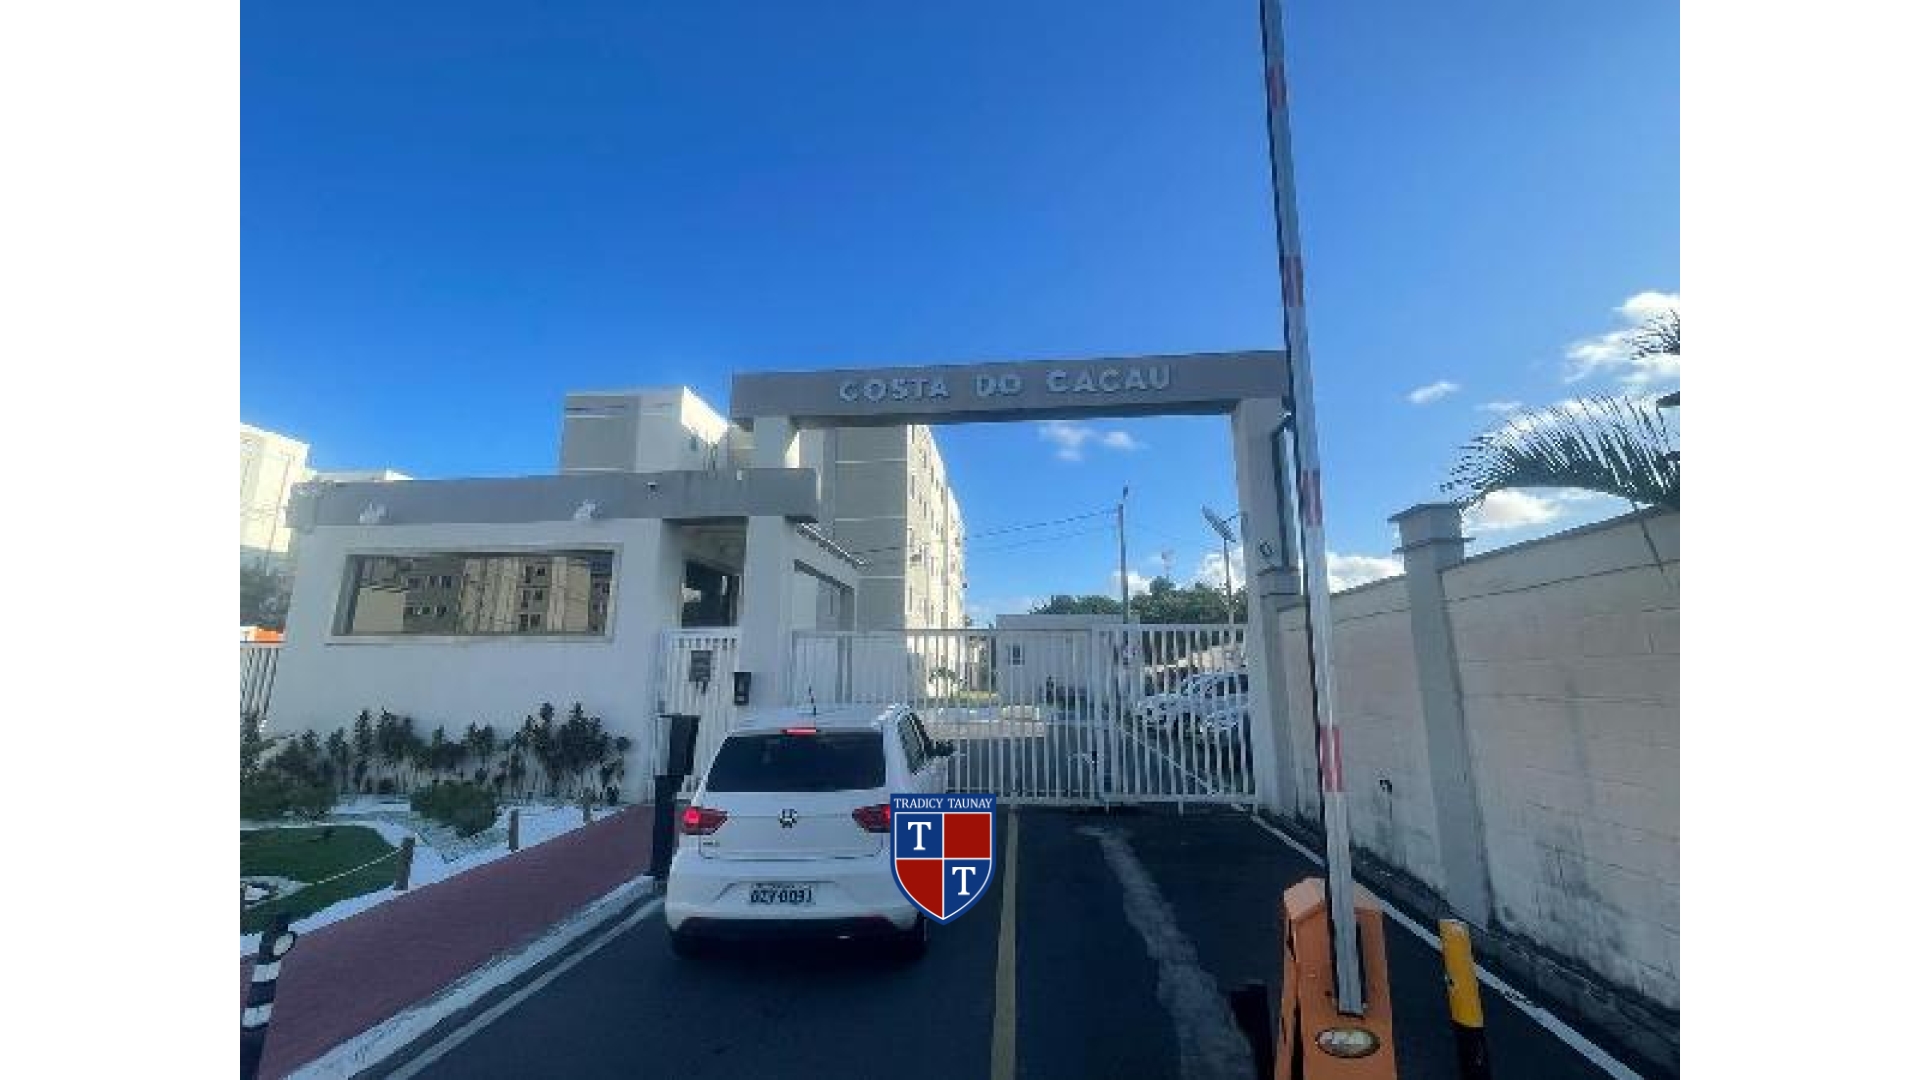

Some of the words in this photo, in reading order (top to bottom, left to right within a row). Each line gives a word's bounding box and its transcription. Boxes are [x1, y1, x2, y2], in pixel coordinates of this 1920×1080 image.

[838, 379, 950, 402] COSTA
[975, 374, 1023, 397] DO
[1049, 364, 1172, 393] CACAU
